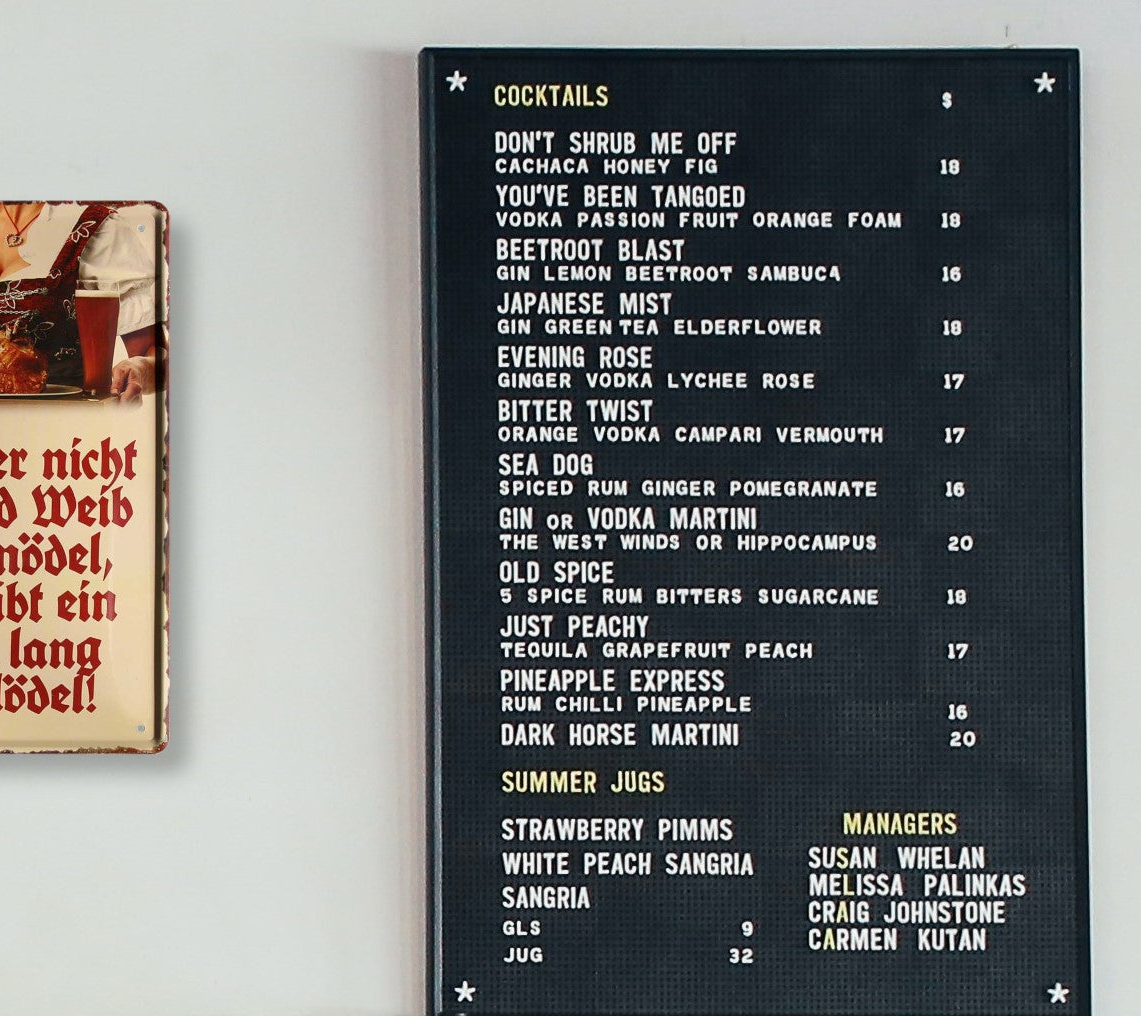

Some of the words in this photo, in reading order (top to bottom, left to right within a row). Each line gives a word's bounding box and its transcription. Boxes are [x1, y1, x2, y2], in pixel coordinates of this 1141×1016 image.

[494, 84, 609, 107] COCKTAILS
[494, 130, 555, 154] DON'T
[569, 131, 636, 155] SHRUB
[651, 131, 683, 155] ME
[697, 131, 737, 155] OFF
[495, 157, 589, 174] CACHACA
[603, 158, 671, 175] HONEY
[685, 158, 718, 175] FIG
[940, 158, 960, 175] 18
[495, 183, 569, 208] YOU'VE
[583, 184, 637, 208] BEEN
[650, 184, 746, 208] TANGOED
[495, 211, 563, 228] VODKA
[577, 211, 665, 228] PASSION
[679, 212, 739, 228] FRUIT
[752, 211, 833, 228] ORANGE
[848, 211, 902, 229] FOAM
[941, 212, 961, 229] 18
[496, 238, 604, 262] BEETROOT
[618, 238, 685, 262] BLAST
[496, 265, 530, 282] GIN
[544, 265, 612, 282] LEMON
[625, 265, 733, 282] BEETROOT
[747, 265, 841, 282] SAMBUCA
[941, 266, 962, 282] 16
[496, 291, 604, 315] JAPANESE
[619, 292, 672, 316] MIST
[497, 318, 531, 335] GIN
[544, 318, 612, 336] GREEN
[618, 319, 659, 336] TEA
[673, 319, 822, 336] ELDERFLOWER
[943, 319, 962, 336] 18
[497, 345, 585, 369] EVENING
[599, 345, 653, 370] ROSE
[497, 372, 572, 389] GINGER
[585, 372, 653, 389] VODKA
[667, 372, 748, 389] LYCHEE
[762, 372, 815, 390] ROSE
[943, 373, 965, 390] 17
[498, 399, 573, 423] BITTER
[585, 399, 653, 423] TWIST
[497, 426, 578, 443] ORANGE
[593, 426, 660, 443] VODKA
[674, 426, 762, 443] CAMPARI
[776, 426, 883, 444] VERMOUTH
[944, 427, 966, 444] 17
[42, 437, 138, 486] nicht
[498, 453, 539, 476] SEA
[553, 453, 594, 476] DOG
[499, 479, 574, 497] SPICED
[587, 480, 628, 497] RUM
[641, 479, 716, 497] GINGER
[729, 480, 877, 498] POMEGRANATE
[945, 481, 965, 498] 16
[31, 485, 134, 528] Weib
[499, 506, 533, 530] GIN
[546, 513, 574, 531] OR
[587, 506, 656, 530] VODKA
[669, 506, 757, 531] MARTINI
[499, 533, 539, 550] THE
[552, 534, 608, 551] WEST
[619, 533, 680, 550] WINDS
[695, 534, 723, 551] OR
[737, 534, 877, 552] HIPPOCAMPUS
[947, 535, 974, 552] 20
[499, 560, 540, 584] OLD
[553, 560, 614, 584] SPICE
[56, 580, 118, 623] ein
[499, 587, 512, 604] 5
[527, 587, 587, 604] SPICE
[602, 587, 643, 605] RUM
[656, 587, 742, 605] BITTERS
[758, 588, 879, 606] SUGARCANE
[947, 588, 967, 605] 18
[499, 614, 554, 638] JUST
[568, 614, 649, 638] PEACHY
[10, 627, 102, 674] lang
[500, 641, 588, 659] TEQUILA
[602, 641, 731, 659] GRAPEFRUIT
[745, 642, 813, 659] PEACH
[947, 643, 969, 660] 17
[500, 668, 616, 692] PINEAPPLE
[630, 669, 725, 693] EXPRESS
[501, 695, 542, 712] RUM
[555, 696, 622, 713] CHILLI
[637, 696, 752, 713] PINEAPPLE
[948, 703, 968, 721] 16
[501, 723, 555, 747] DARK
[569, 722, 637, 746] HORSE
[651, 722, 739, 747] MARTINI
[949, 730, 976, 748] 20
[501, 770, 597, 794] SUMMER
[610, 770, 665, 793] JUGS
[501, 818, 644, 842] STRAWBERRY
[658, 818, 733, 842] PIMMS
[843, 812, 958, 836] MANAGERS
[502, 851, 570, 876] WHITE
[583, 851, 652, 876] PEACH
[665, 852, 754, 876] SANGRIA
[808, 846, 877, 870] SUSAN
[897, 846, 985, 870] WHELAN
[809, 873, 904, 897] MELISSA
[924, 873, 1026, 897] PALINKAS
[502, 885, 591, 910] SANGRIA
[808, 900, 870, 924] CRAIG
[883, 900, 1006, 924] JOHNSTONE
[502, 920, 541, 936] GLS
[741, 920, 754, 937] 9
[808, 927, 898, 951] CARMEN
[918, 927, 986, 952] KUTAN
[503, 946, 543, 963] JUG
[729, 947, 754, 964] 32
